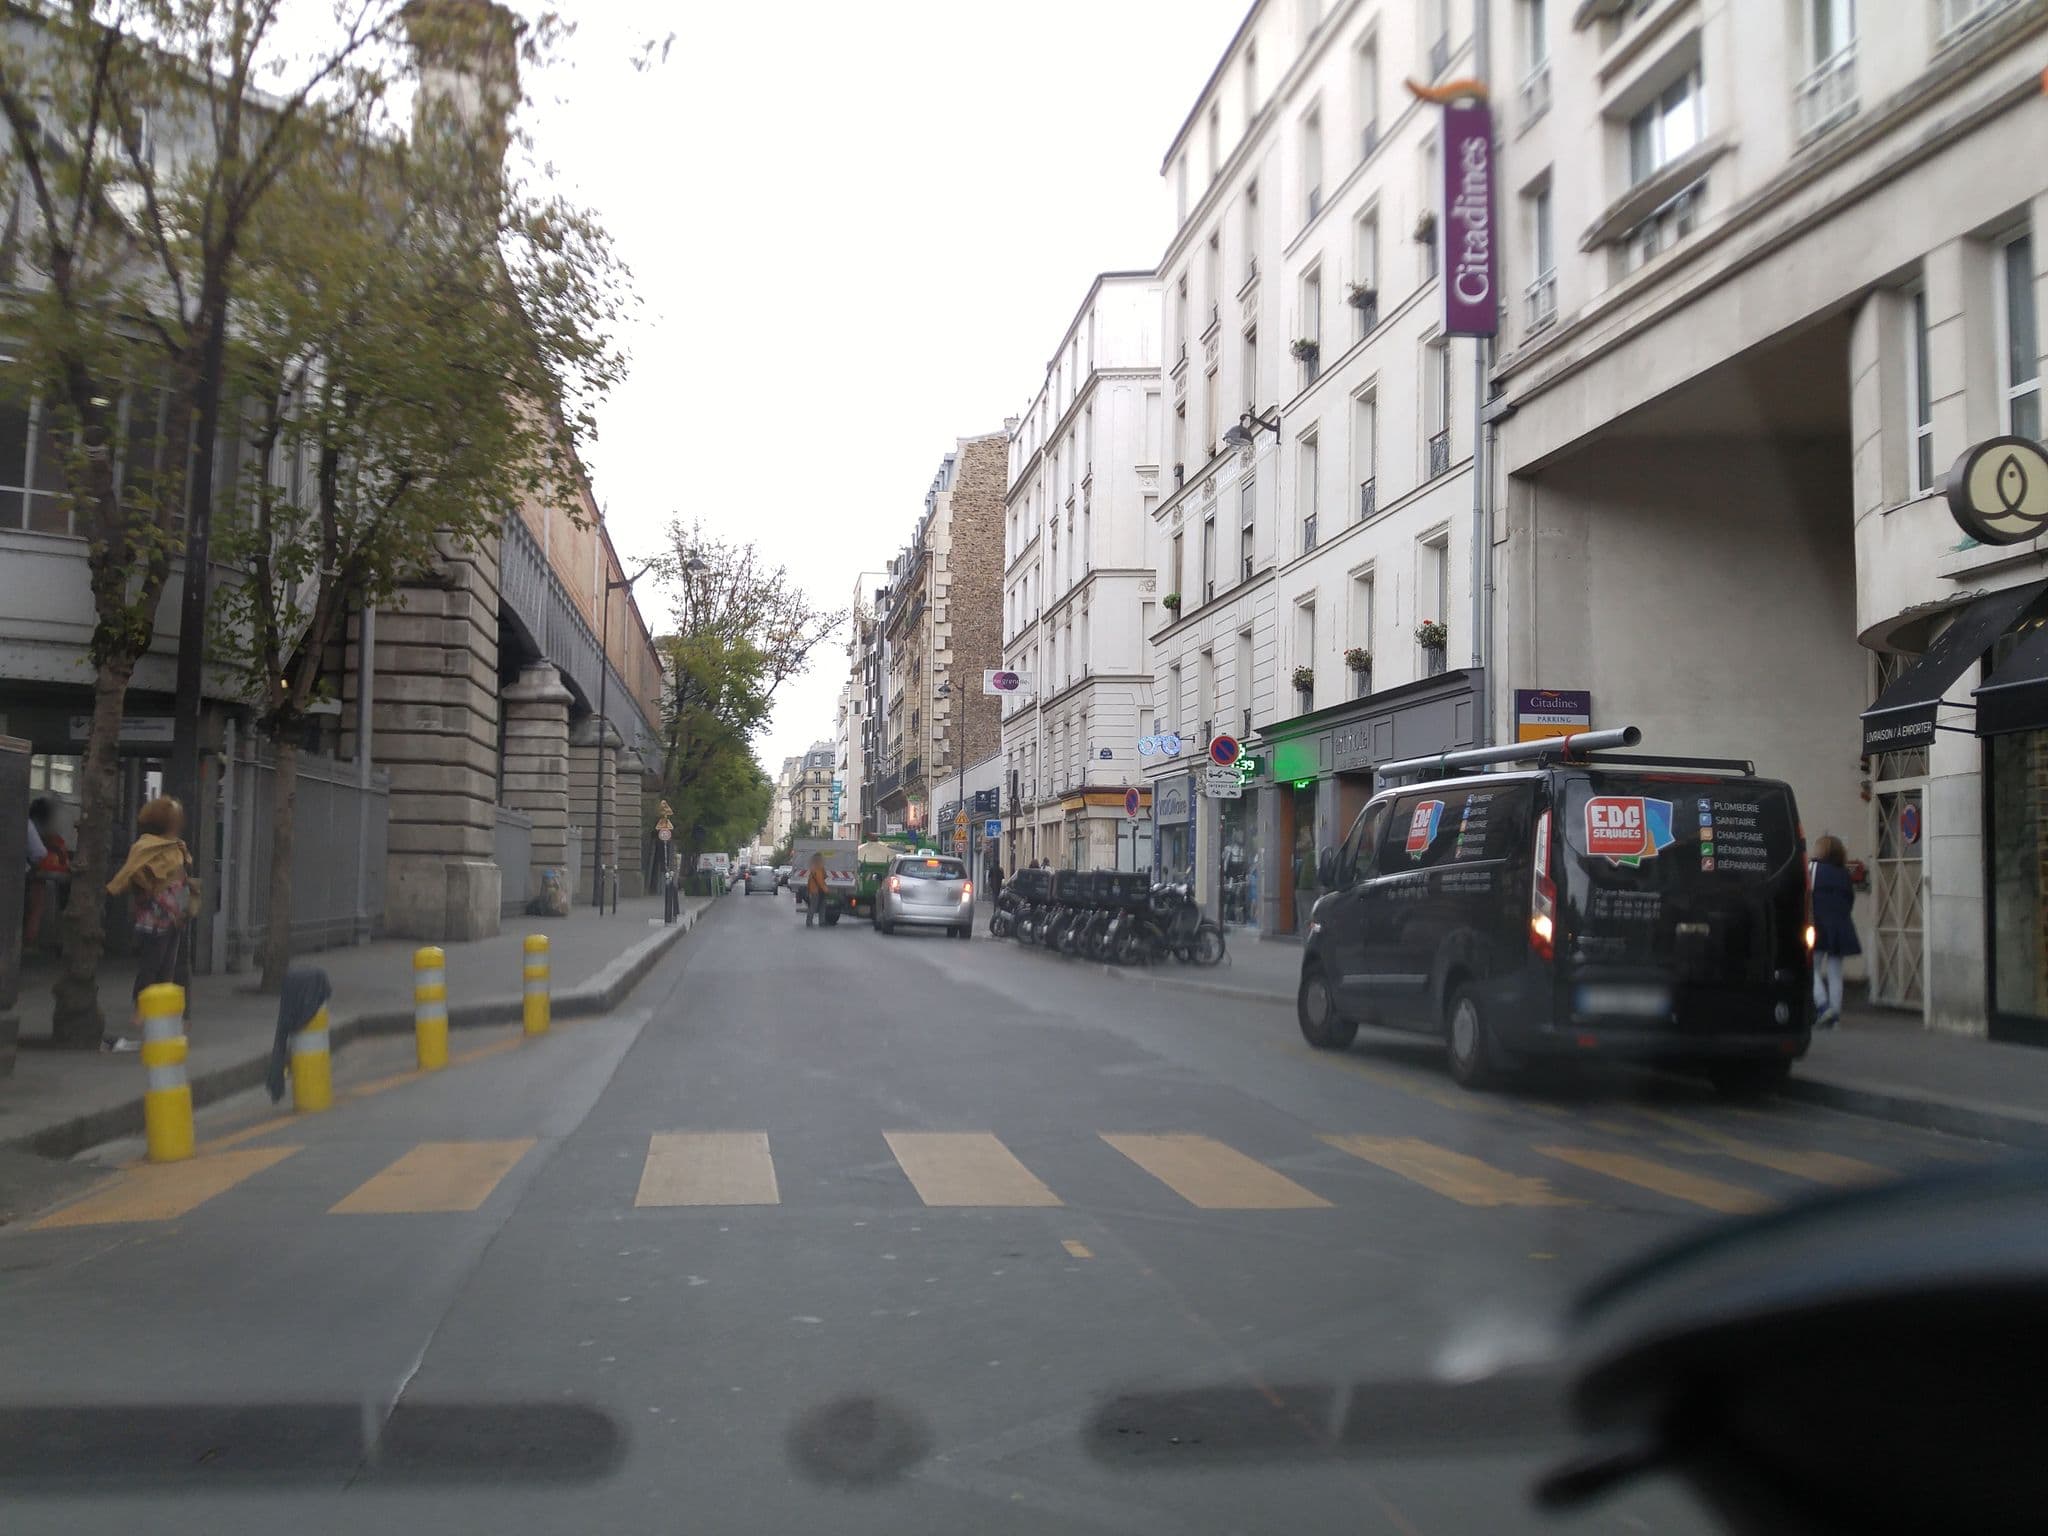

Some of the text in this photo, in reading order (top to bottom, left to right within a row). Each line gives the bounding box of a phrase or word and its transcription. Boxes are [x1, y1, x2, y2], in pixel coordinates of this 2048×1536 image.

[1452, 136, 1489, 305] Citadines
[1530, 696, 1578, 709] Citadines
[1537, 715, 1572, 724] PARKING
[1866, 728, 1893, 743] LIVRAISON
[1714, 801, 1760, 813] PLOMBERIE
[1590, 805, 1640, 828] EDC
[1715, 816, 1757, 827] SANITAIRE
[1593, 828, 1641, 840] SERVICES
[1716, 831, 1764, 842] CHAUFFAGE
[1717, 859, 1767, 871] DÉPANNAGE
